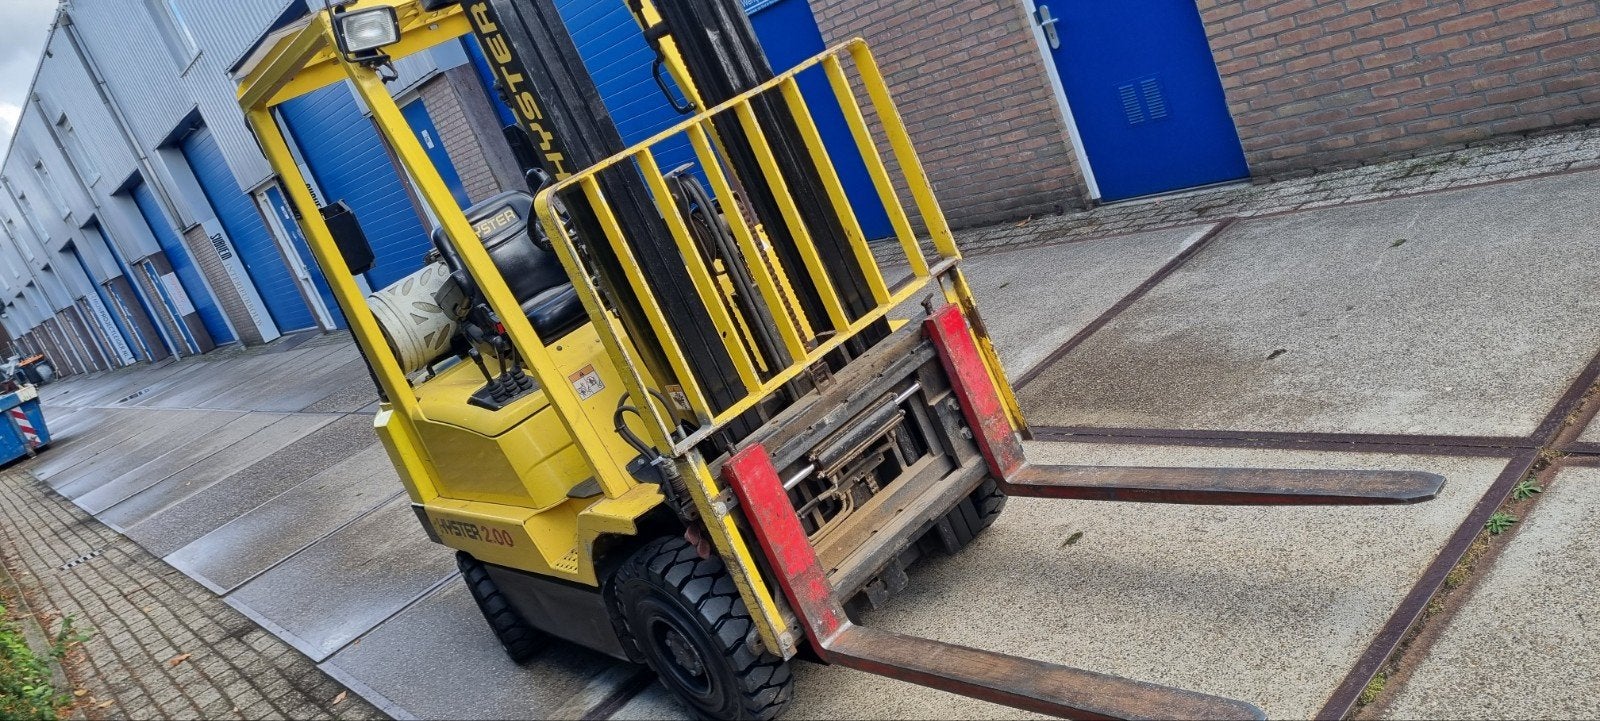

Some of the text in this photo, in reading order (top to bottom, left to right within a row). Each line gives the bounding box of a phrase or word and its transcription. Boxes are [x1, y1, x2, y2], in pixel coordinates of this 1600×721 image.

[470, 2, 572, 181] HYSTER
[475, 209, 516, 238] YSTER
[481, 526, 514, 547] 2.00
